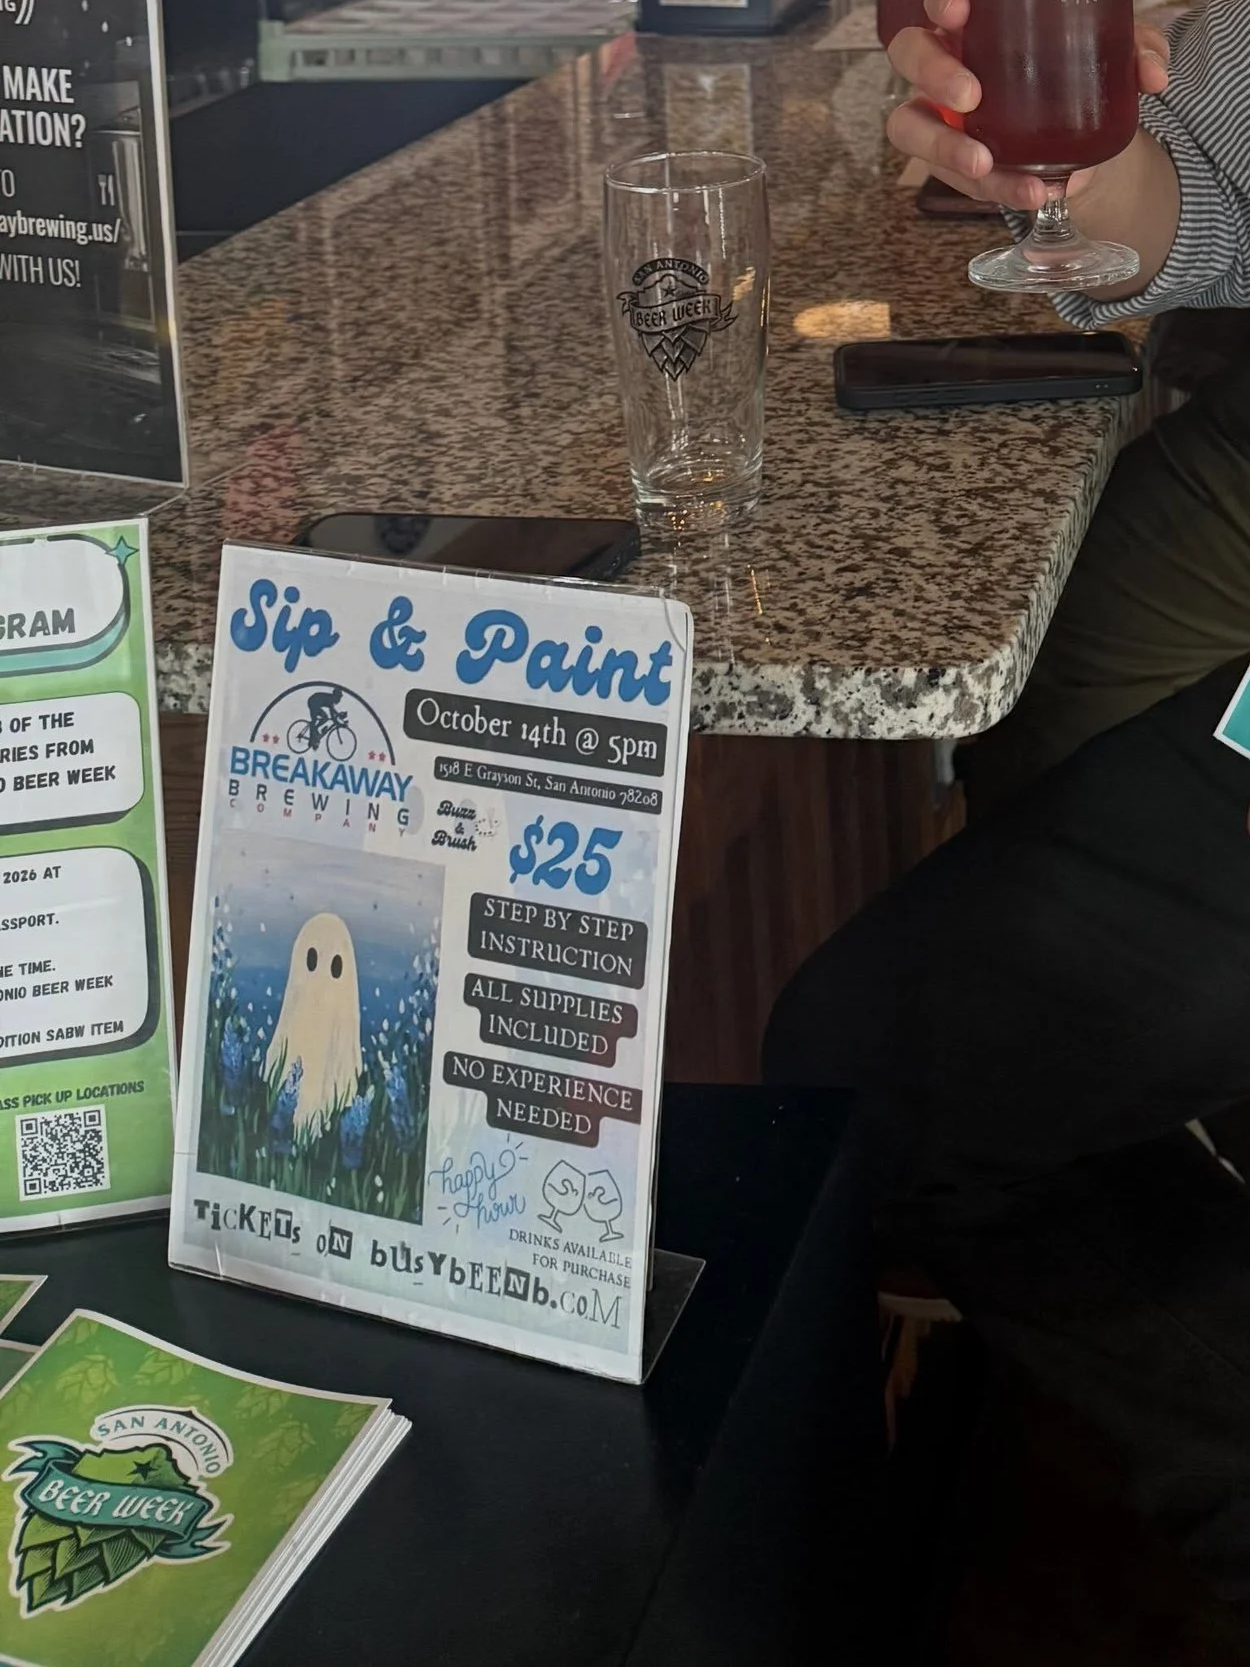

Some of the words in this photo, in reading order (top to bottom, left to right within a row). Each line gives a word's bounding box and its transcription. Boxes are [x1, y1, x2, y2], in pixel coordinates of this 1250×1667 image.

[3, 65, 74, 104] MAKE
[48, 257, 81, 288] US!
[634, 263, 653, 283] SAN
[656, 260, 708, 284] ANTONIO
[636, 310, 667, 328] BEER
[672, 299, 712, 322] WEEK
[230, 578, 340, 674] Sip
[369, 595, 427, 672] &
[455, 609, 673, 706] Paint
[9, 716, 32, 733] OF
[38, 712, 75, 731] THE
[416, 697, 513, 738] October
[520, 716, 567, 749] 14th
[575, 727, 600, 755] @
[607, 734, 658, 765] 5pm
[45, 738, 95, 759] FROM
[13, 771, 60, 792] BEER
[66, 764, 117, 785] WEEK
[230, 745, 413, 802] BREAKAWAY
[464, 762, 474, 777] E
[476, 764, 522, 789] Grayson
[525, 773, 542, 791] St,
[544, 775, 567, 792] San
[569, 780, 617, 801] Antonio
[619, 789, 659, 807] 78208
[228, 778, 410, 826] BREWING
[229, 798, 406, 837] COMPANY
[437, 800, 477, 821] Buzz
[431, 830, 477, 852] Brush
[455, 822, 464, 835] &
[43, 865, 61, 880] AT
[509, 814, 623, 896] $25
[0, 913, 59, 932] SSPORT.
[483, 898, 538, 925] STEP
[543, 909, 572, 931] BY
[578, 915, 634, 942] STEP
[18, 959, 56, 976] TIME.
[480, 930, 633, 977] INSTRUCTION
[32, 980, 69, 997] BEER
[75, 975, 114, 992] WEEK
[471, 978, 513, 1003] ALL
[519, 987, 623, 1024] SUPPLIES
[46, 1025, 85, 1042] SABW
[90, 1020, 124, 1037] ITEM
[488, 1014, 609, 1055] INCLUDED
[22, 1092, 52, 1108] PICK
[55, 1087, 72, 1104] UP
[76, 1080, 145, 1101] LOCATIONS
[452, 1056, 485, 1080] NO
[491, 1064, 634, 1111] EXPERIENCE
[496, 1098, 592, 1135] NEEDED
[428, 1150, 516, 1201] happy
[508, 1228, 561, 1251] DRINKS
[563, 1240, 632, 1269] AVAILABLE
[532, 1253, 558, 1271] FOR
[562, 1260, 632, 1289] PURCHASE
[97, 1415, 145, 1438] SAN
[153, 1417, 221, 1474] ANTONIO
[38, 1478, 111, 1517] BEER
[111, 1494, 196, 1526] WEEK
